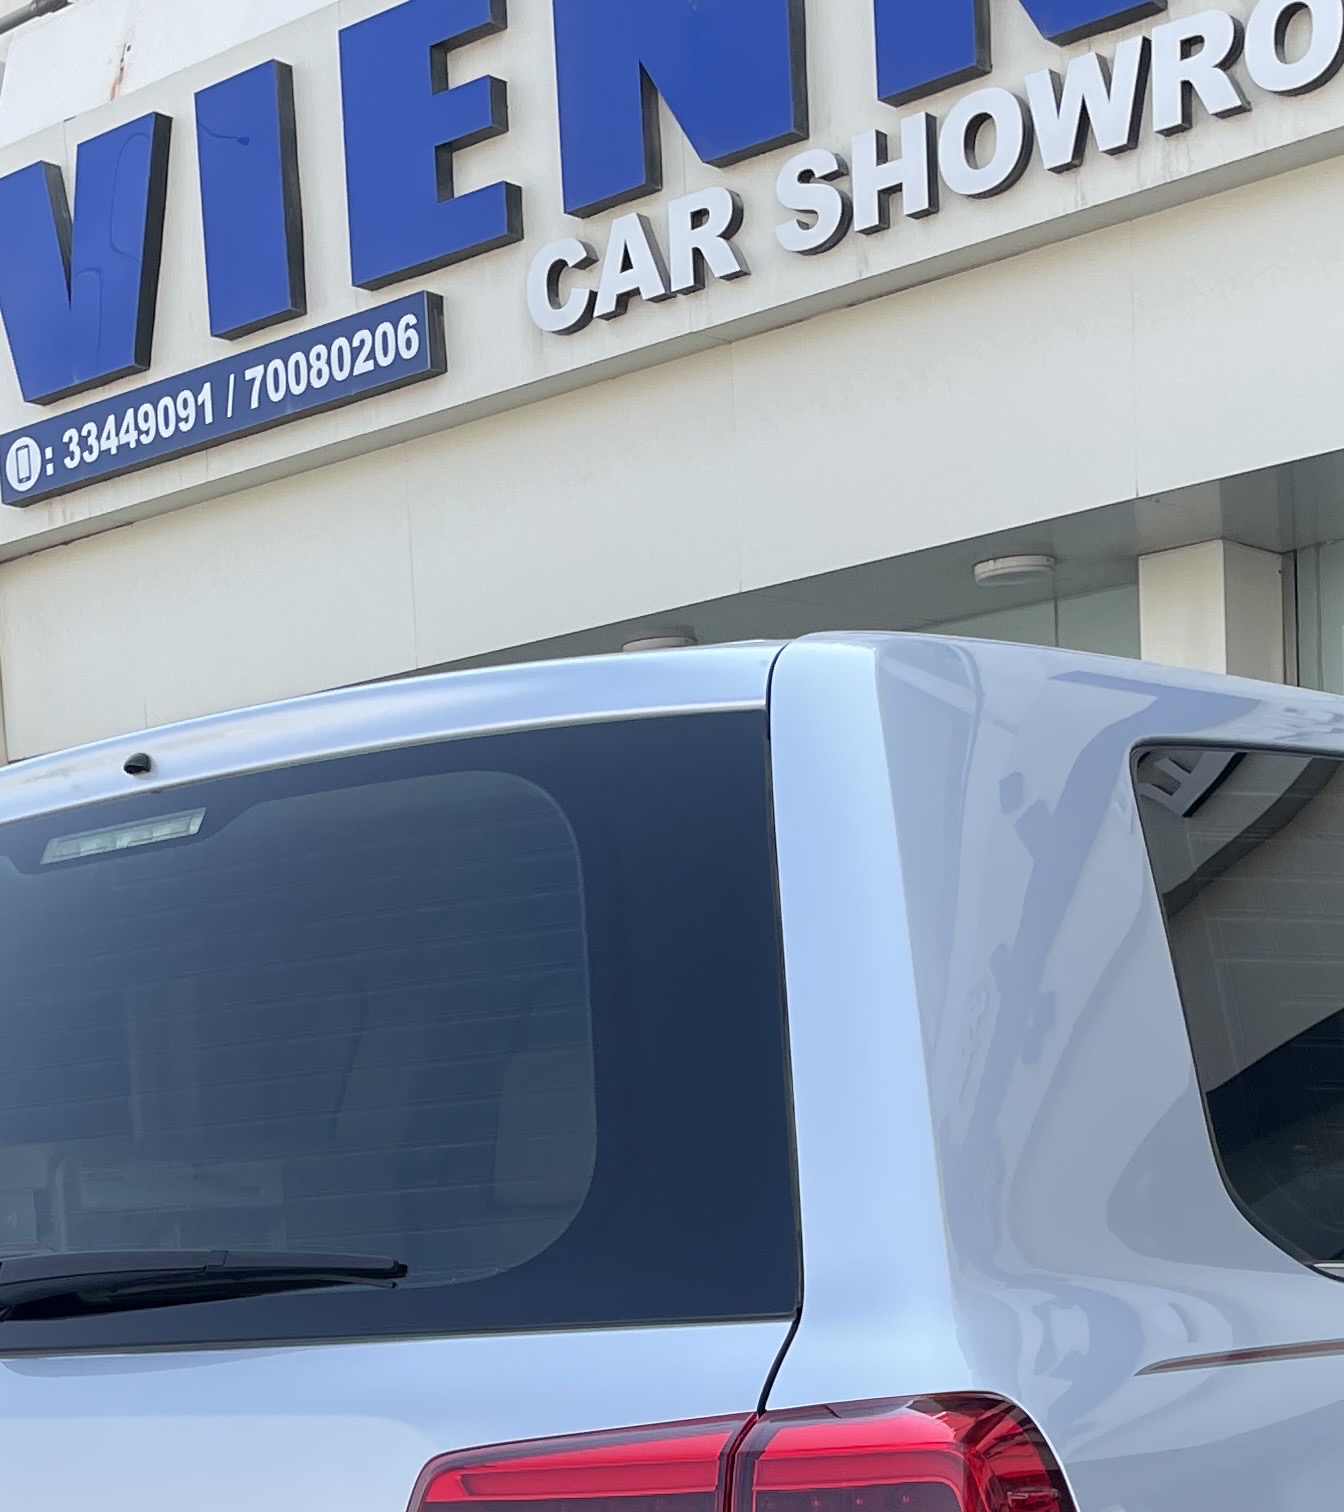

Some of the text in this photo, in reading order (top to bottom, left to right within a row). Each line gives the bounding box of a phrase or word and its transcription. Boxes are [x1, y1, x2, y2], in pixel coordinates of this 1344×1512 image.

[526, 185, 750, 336] CAR
[61, 381, 216, 471] 33449091
[244, 312, 421, 405] 70080206
